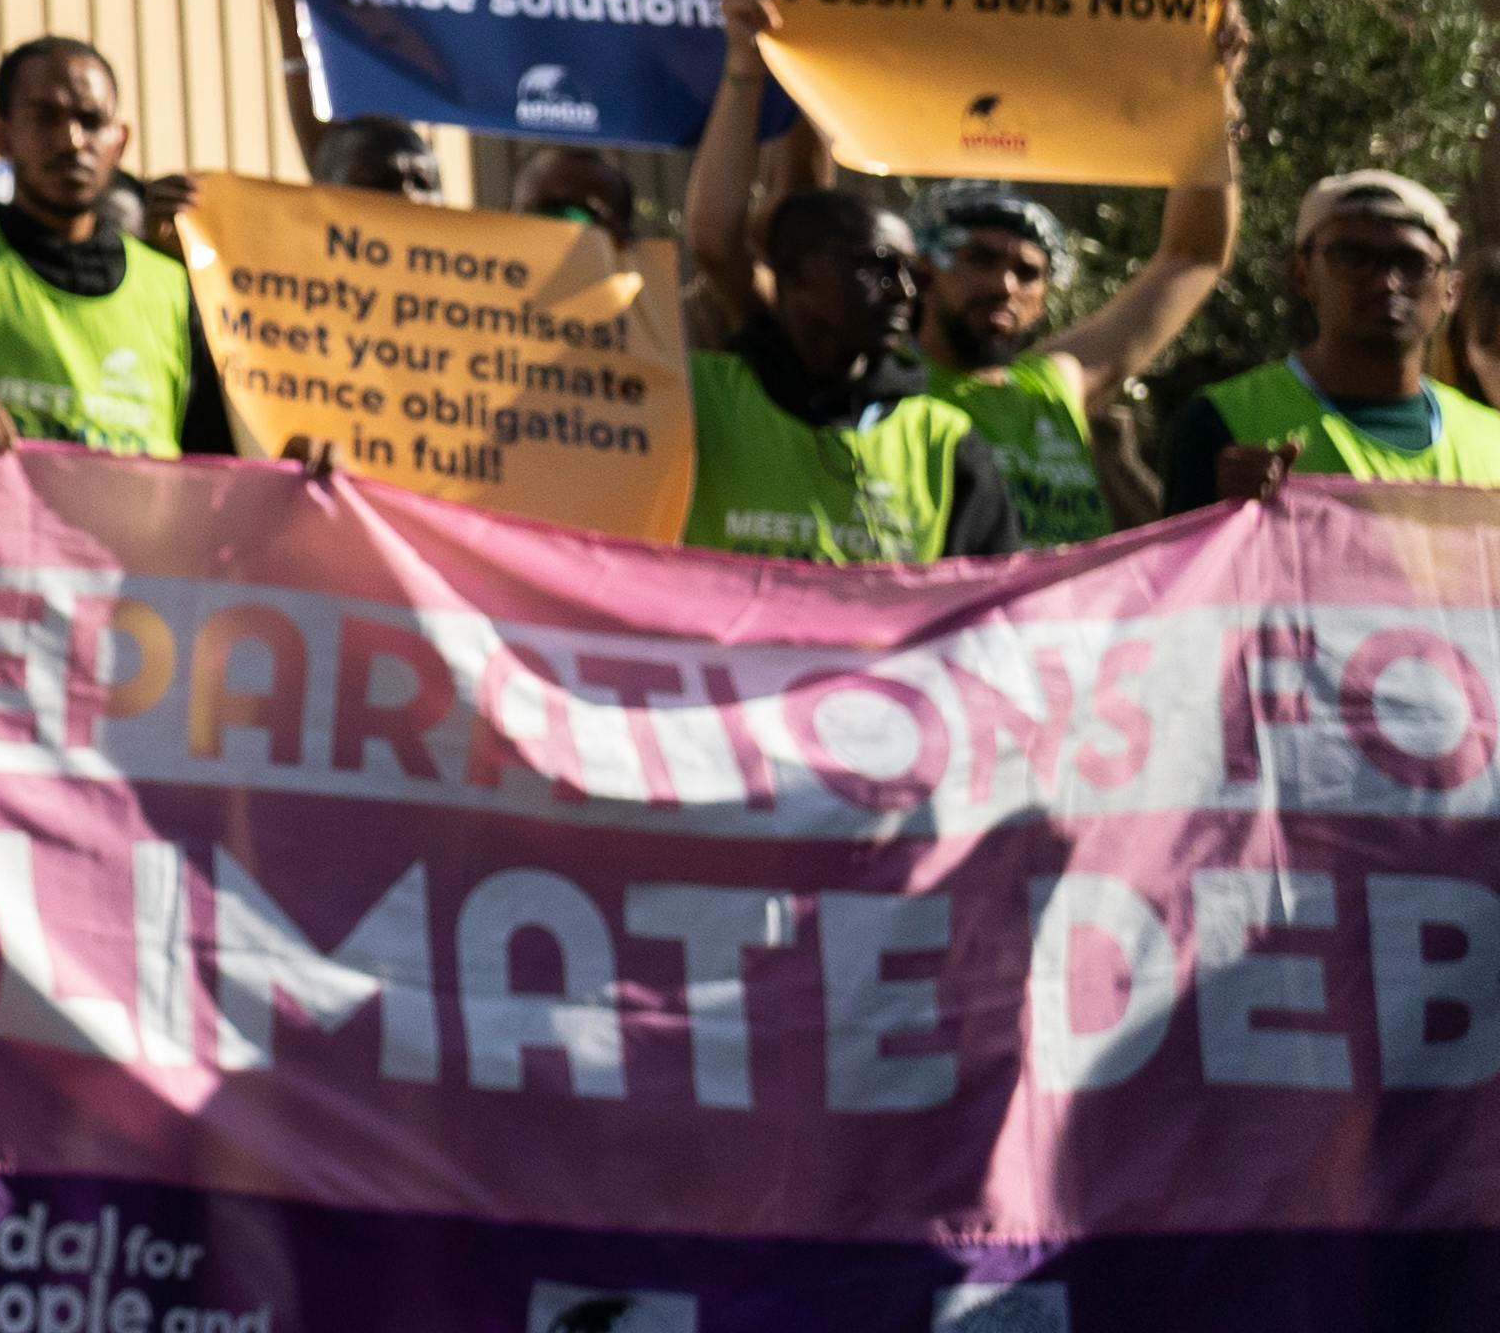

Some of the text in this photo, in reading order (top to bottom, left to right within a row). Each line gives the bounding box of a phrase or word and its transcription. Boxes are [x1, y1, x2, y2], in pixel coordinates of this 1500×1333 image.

[324, 222, 531, 288] No more
[229, 264, 631, 353] empty promises!
[220, 303, 648, 407] Meet your climate
[352, 423, 506, 485] in full!
[401, 385, 651, 456] obligation
[124, 1224, 205, 1281] for
